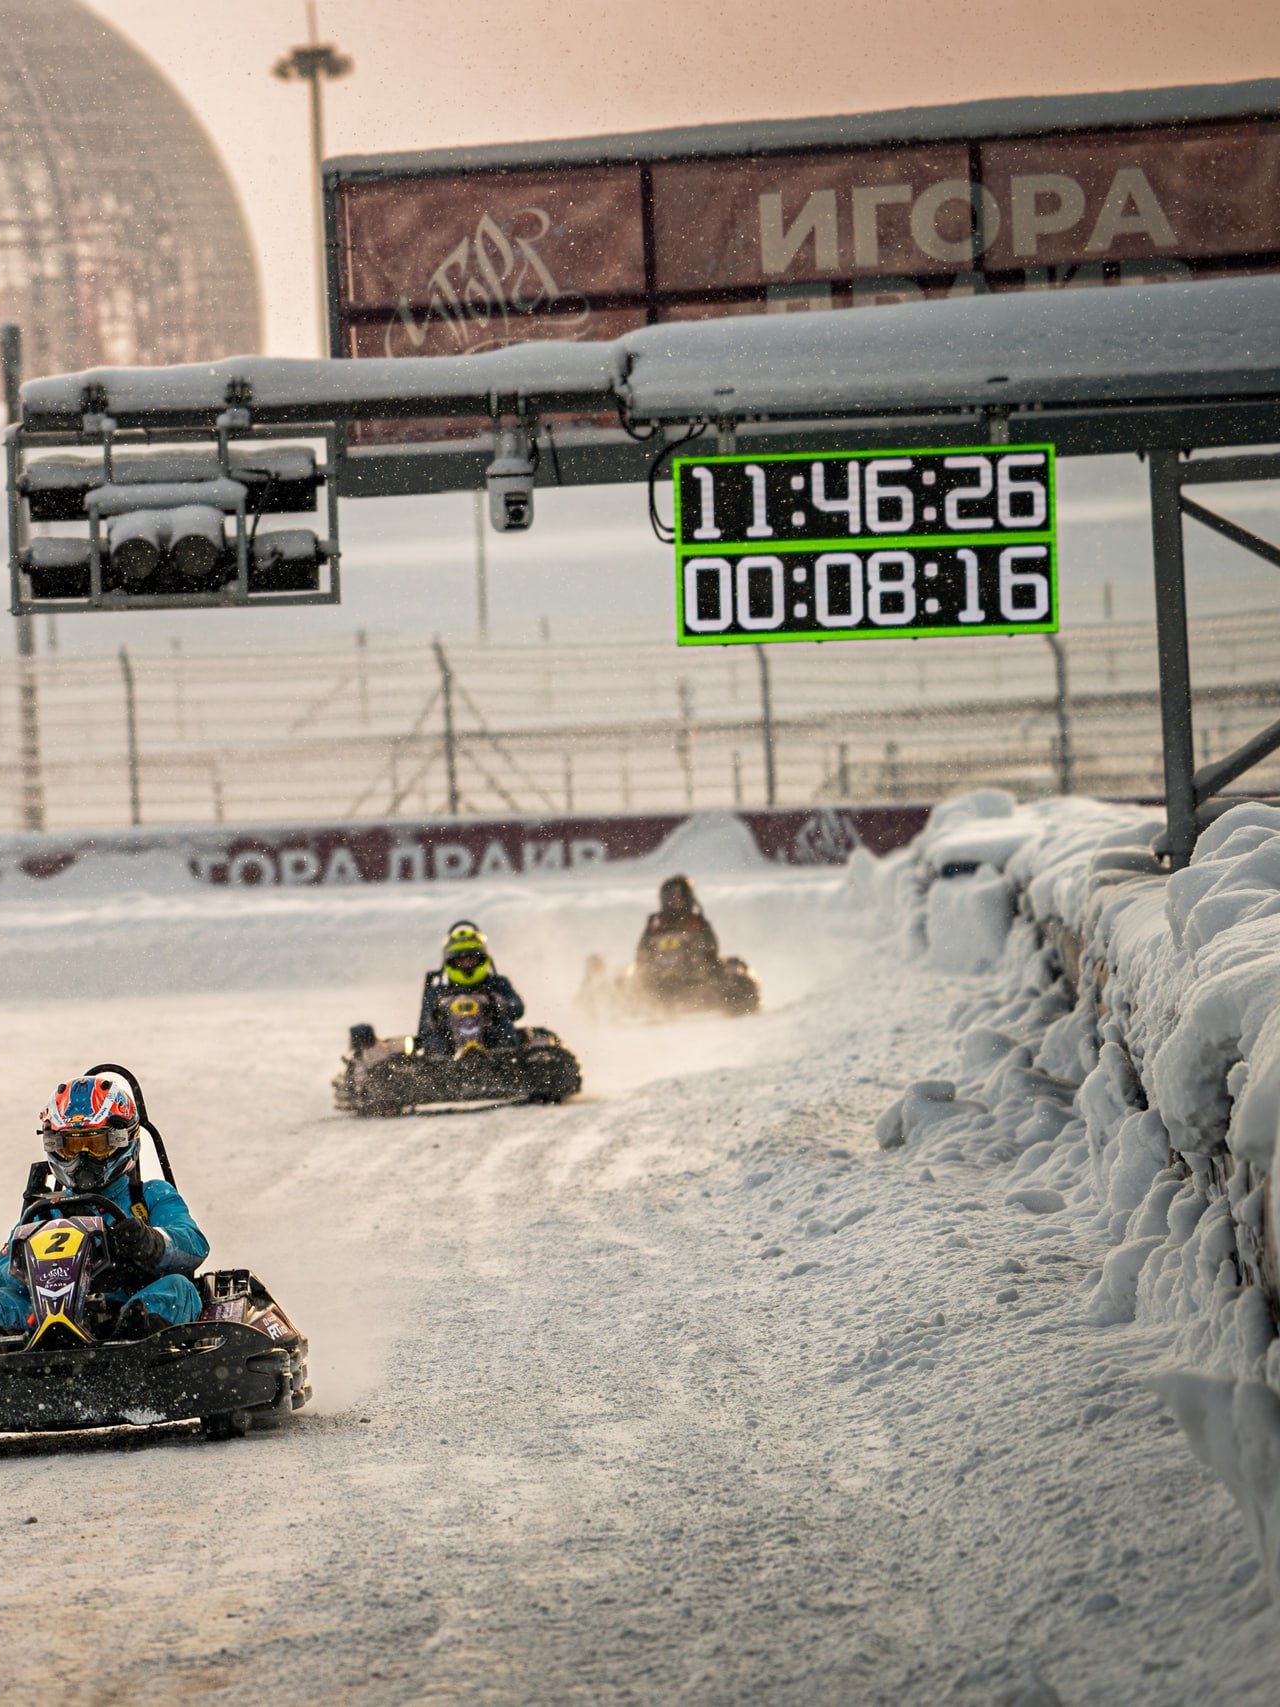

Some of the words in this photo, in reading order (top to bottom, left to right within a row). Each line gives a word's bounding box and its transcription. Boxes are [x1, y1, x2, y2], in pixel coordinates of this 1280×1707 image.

[758, 167, 1178, 275] ИГОРА
[692, 453, 1048, 540] 11:46:26
[684, 545, 1050, 632] 00:08:16
[44, 1232, 71, 1255] 2
